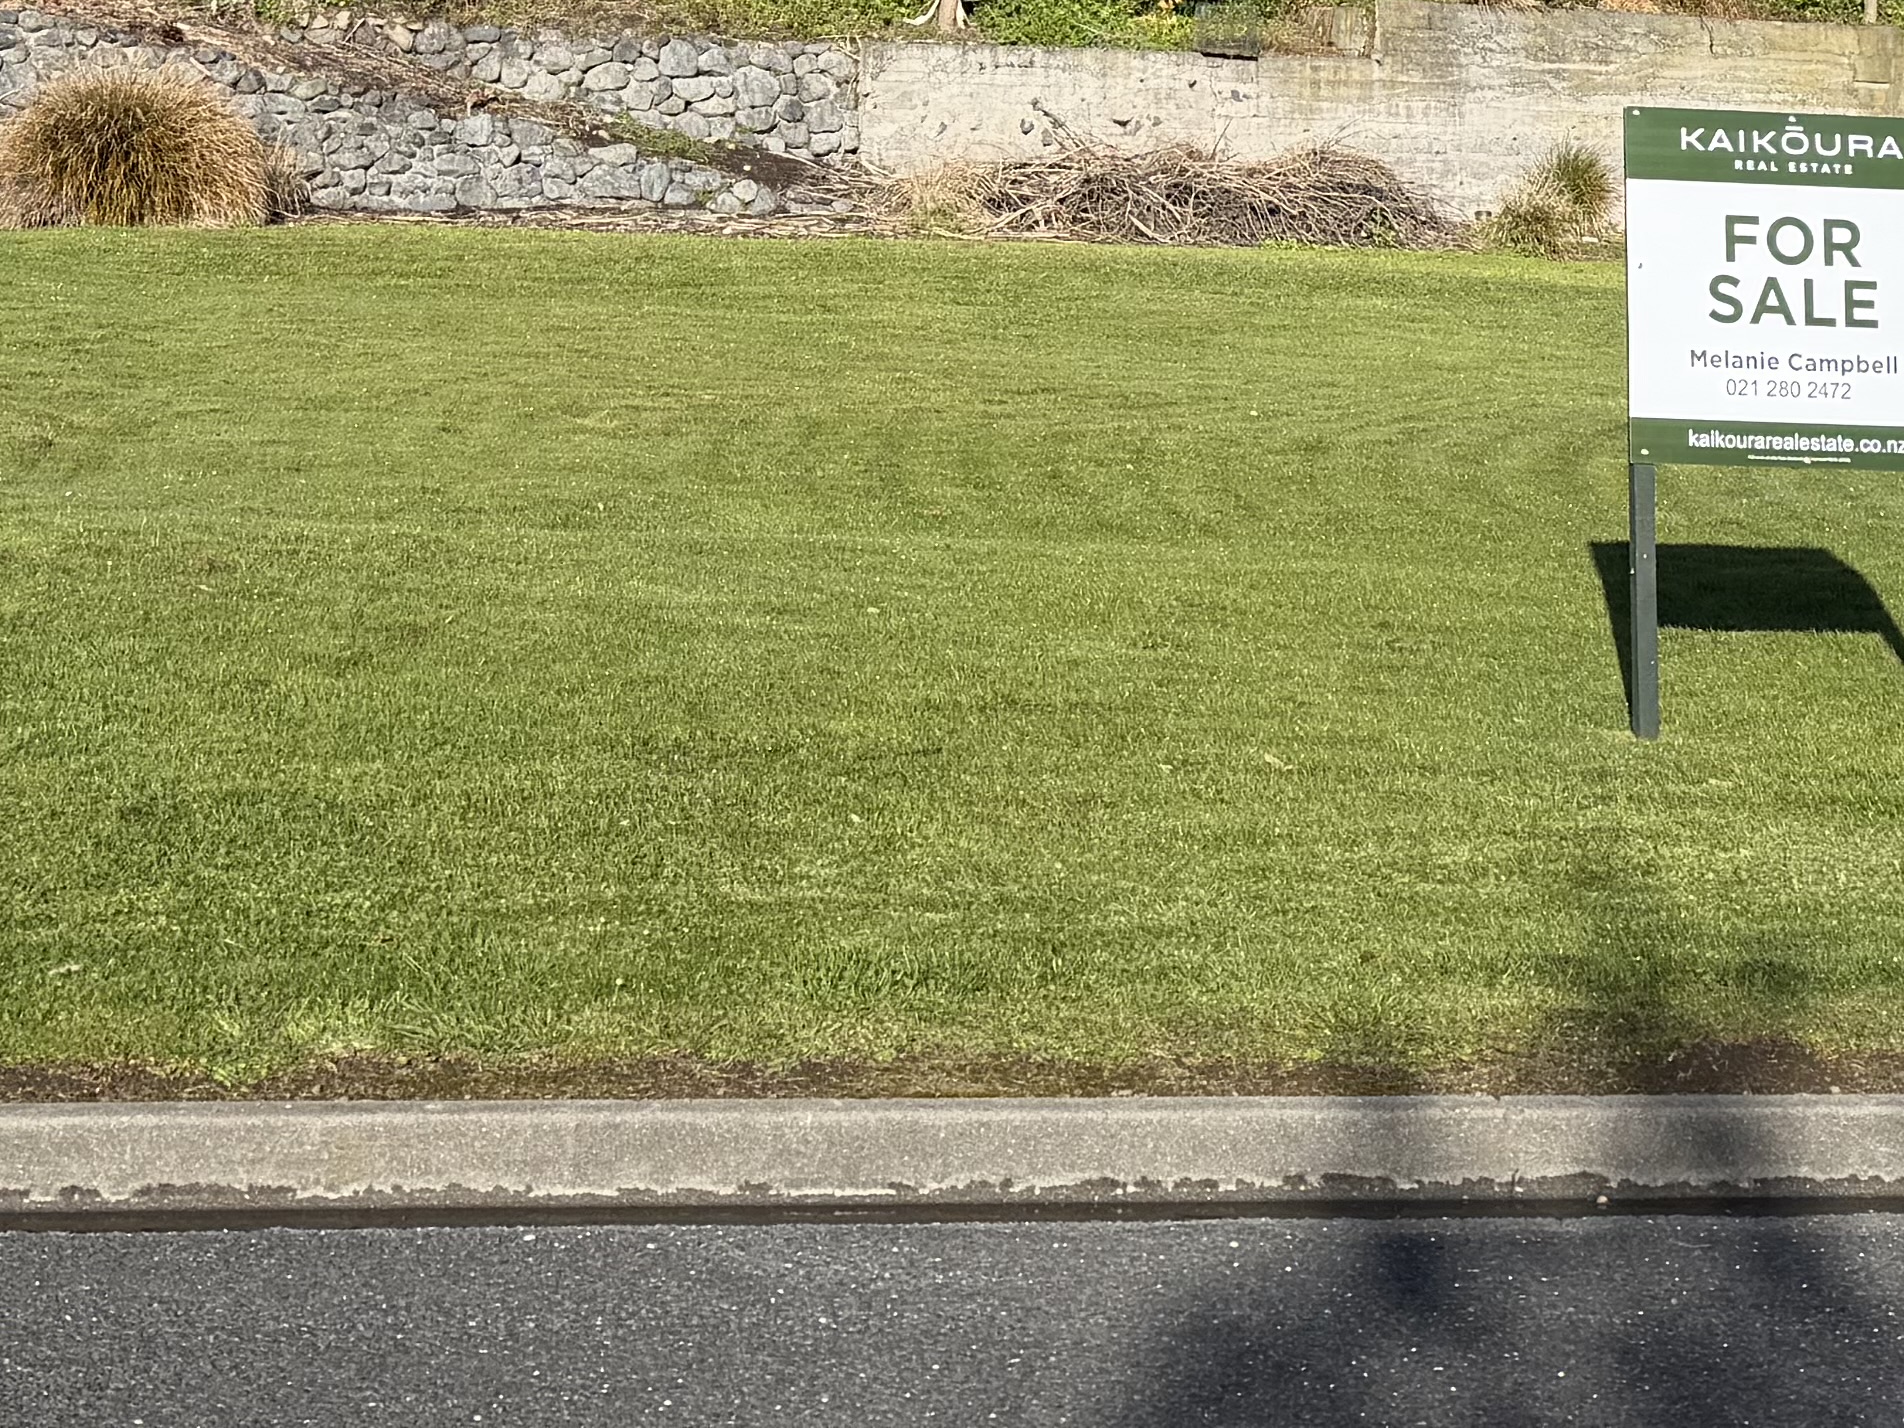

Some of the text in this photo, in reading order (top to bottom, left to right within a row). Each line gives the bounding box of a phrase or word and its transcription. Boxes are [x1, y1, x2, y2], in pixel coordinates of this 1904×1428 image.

[1734, 159, 1853, 175] REAL ESTATE
[1724, 214, 1861, 268] FOR
[1708, 275, 1879, 328] SALE
[1690, 349, 1898, 376] Melanie Campbell
[1726, 379, 1851, 399] 021 280 2472
